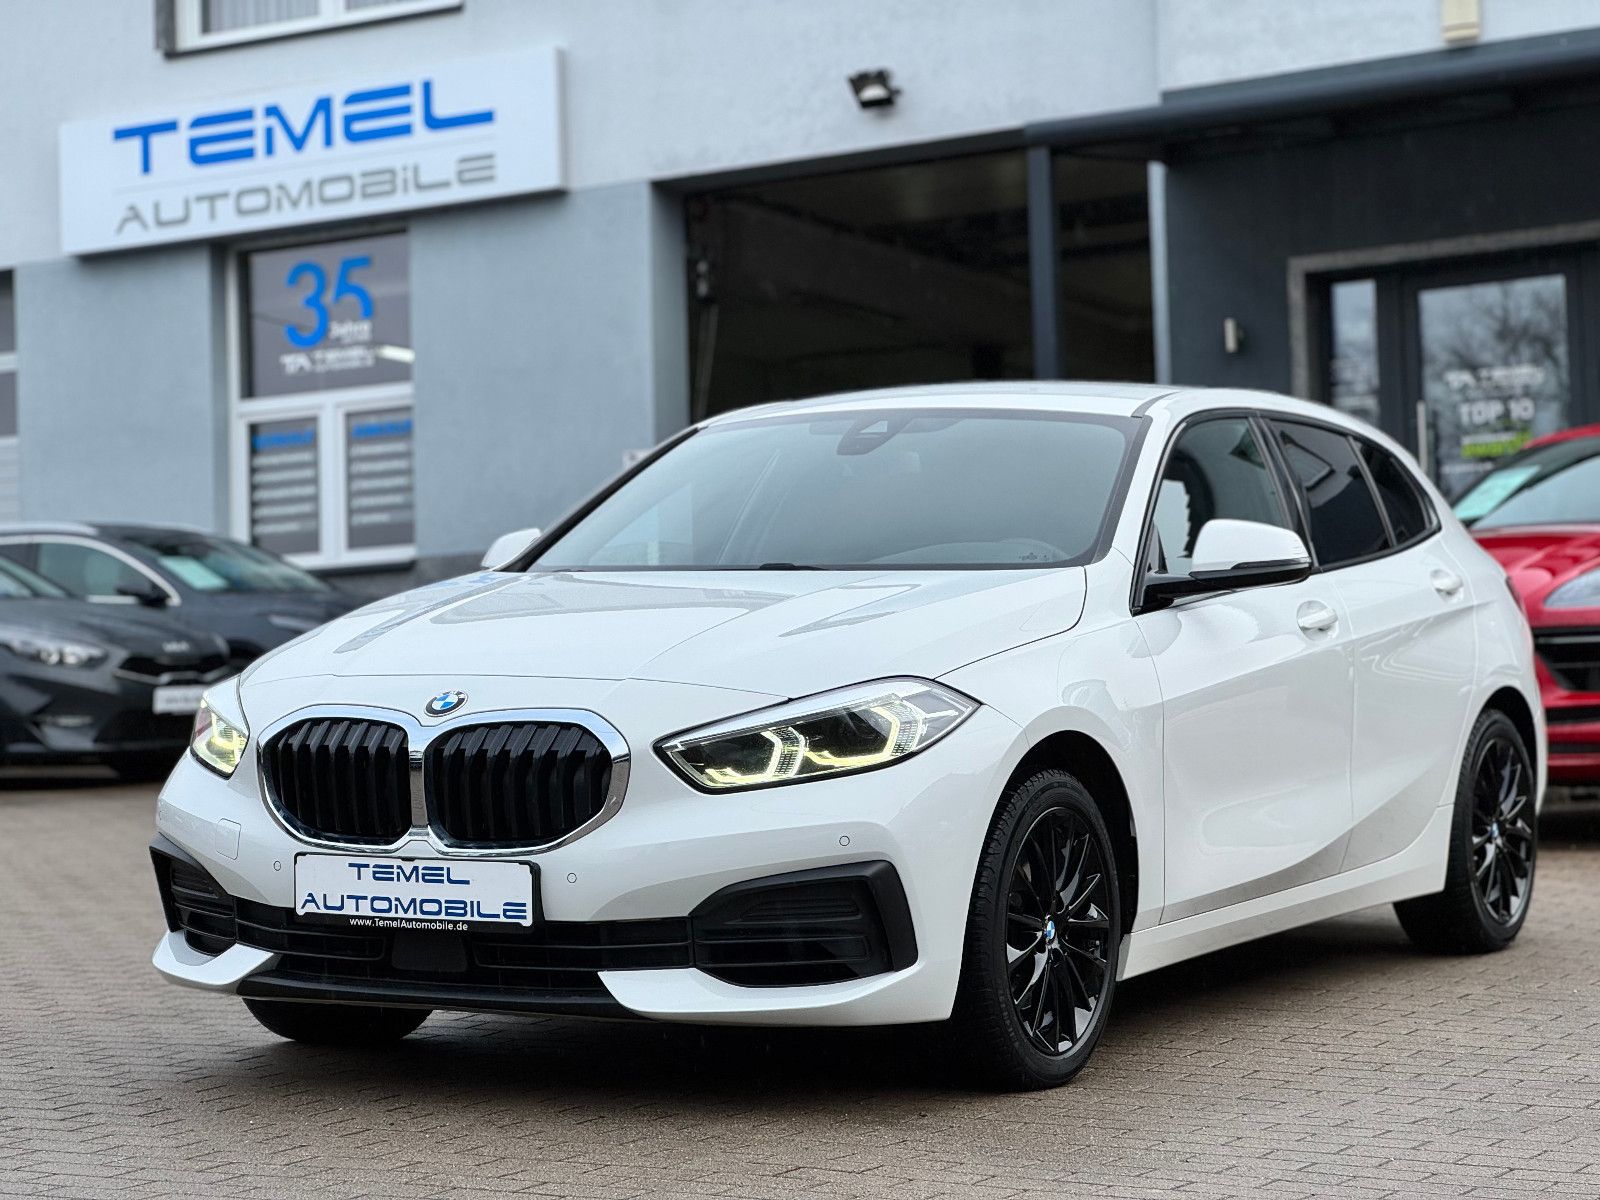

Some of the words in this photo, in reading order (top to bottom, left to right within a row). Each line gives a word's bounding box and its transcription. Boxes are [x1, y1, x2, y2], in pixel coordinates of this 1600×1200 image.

[114, 80, 495, 175] TEMEL
[286, 257, 374, 347] 35
[1459, 400, 1504, 426] TOP
[1508, 398, 1534, 422] 10
[348, 862, 471, 885] TEMEL
[300, 892, 528, 920] AUTOMOBILE
[349, 918, 469, 931] www.TemelAutomobile.de
